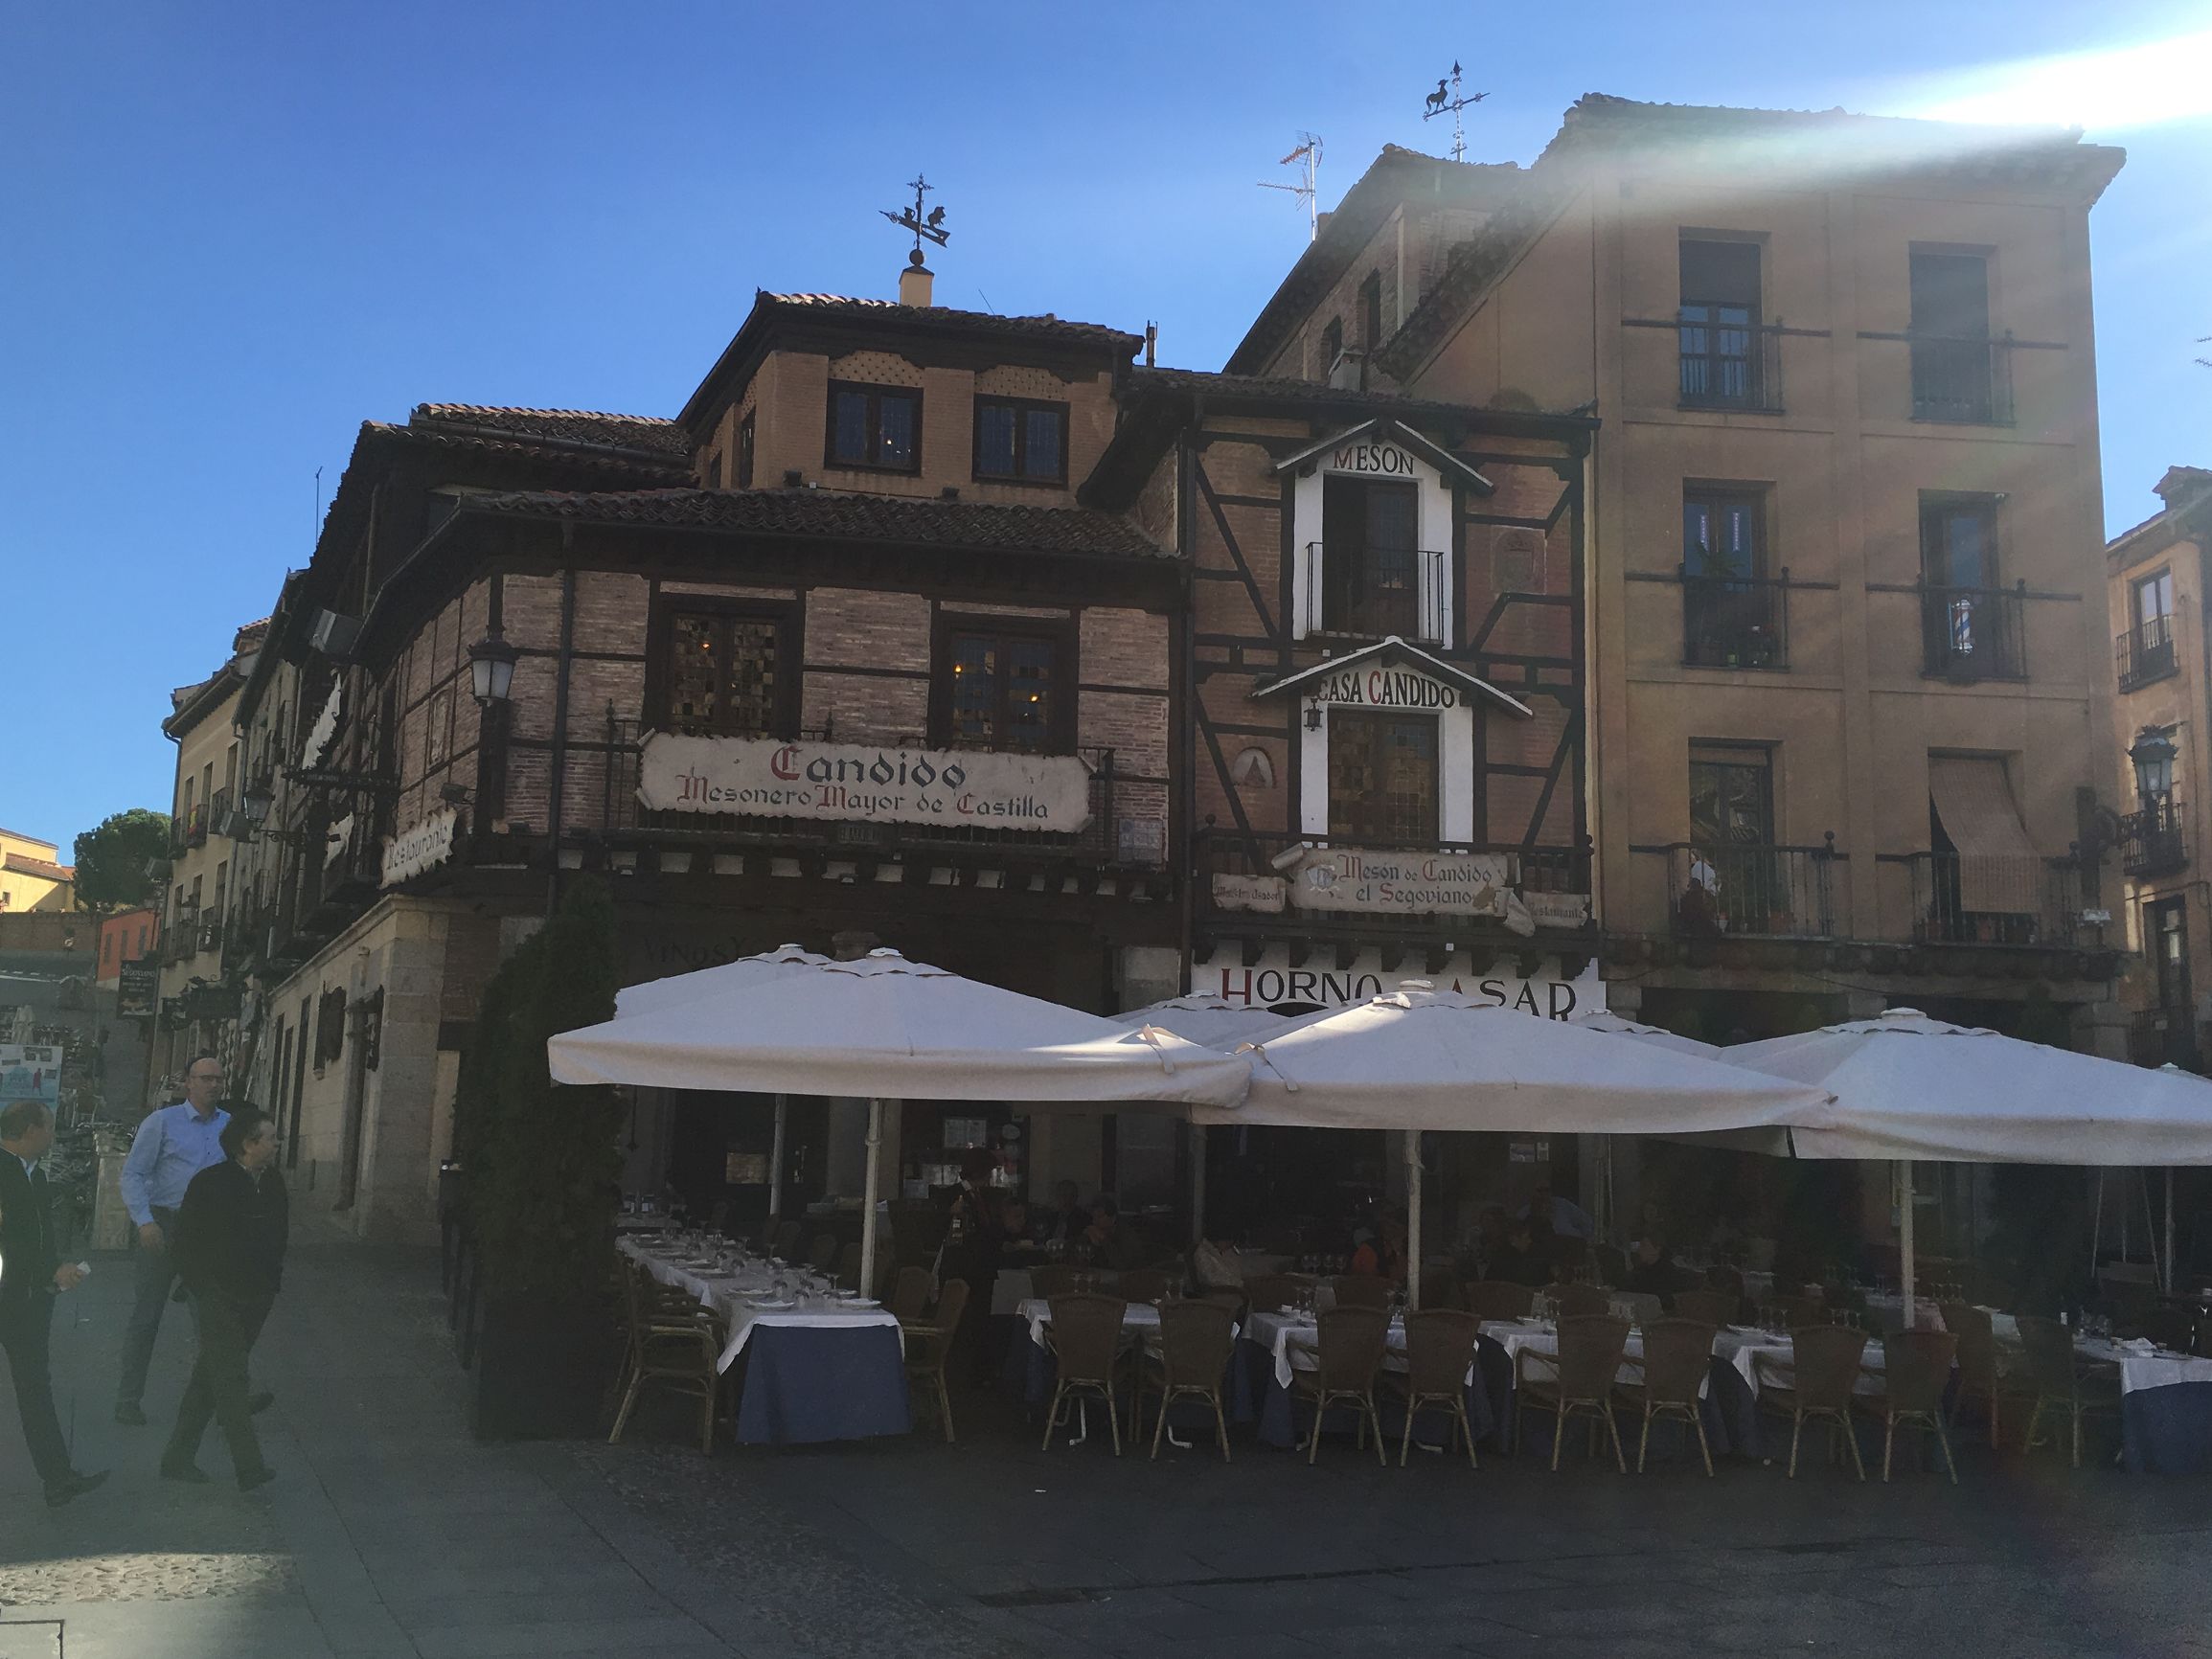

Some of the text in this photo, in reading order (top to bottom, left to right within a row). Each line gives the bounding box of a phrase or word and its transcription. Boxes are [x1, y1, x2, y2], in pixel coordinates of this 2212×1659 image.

[1334, 444, 1413, 475] MESON
[1317, 670, 1455, 708] CASA CANDIDO
[770, 745, 967, 788] Candido
[675, 770, 1049, 819] Mesonero Mayor de Castilla
[1404, 868, 1418, 881] de
[1423, 858, 1492, 882] Candido
[1356, 882, 1472, 909] el Segoviano
[1221, 968, 1382, 1005] HORNO
